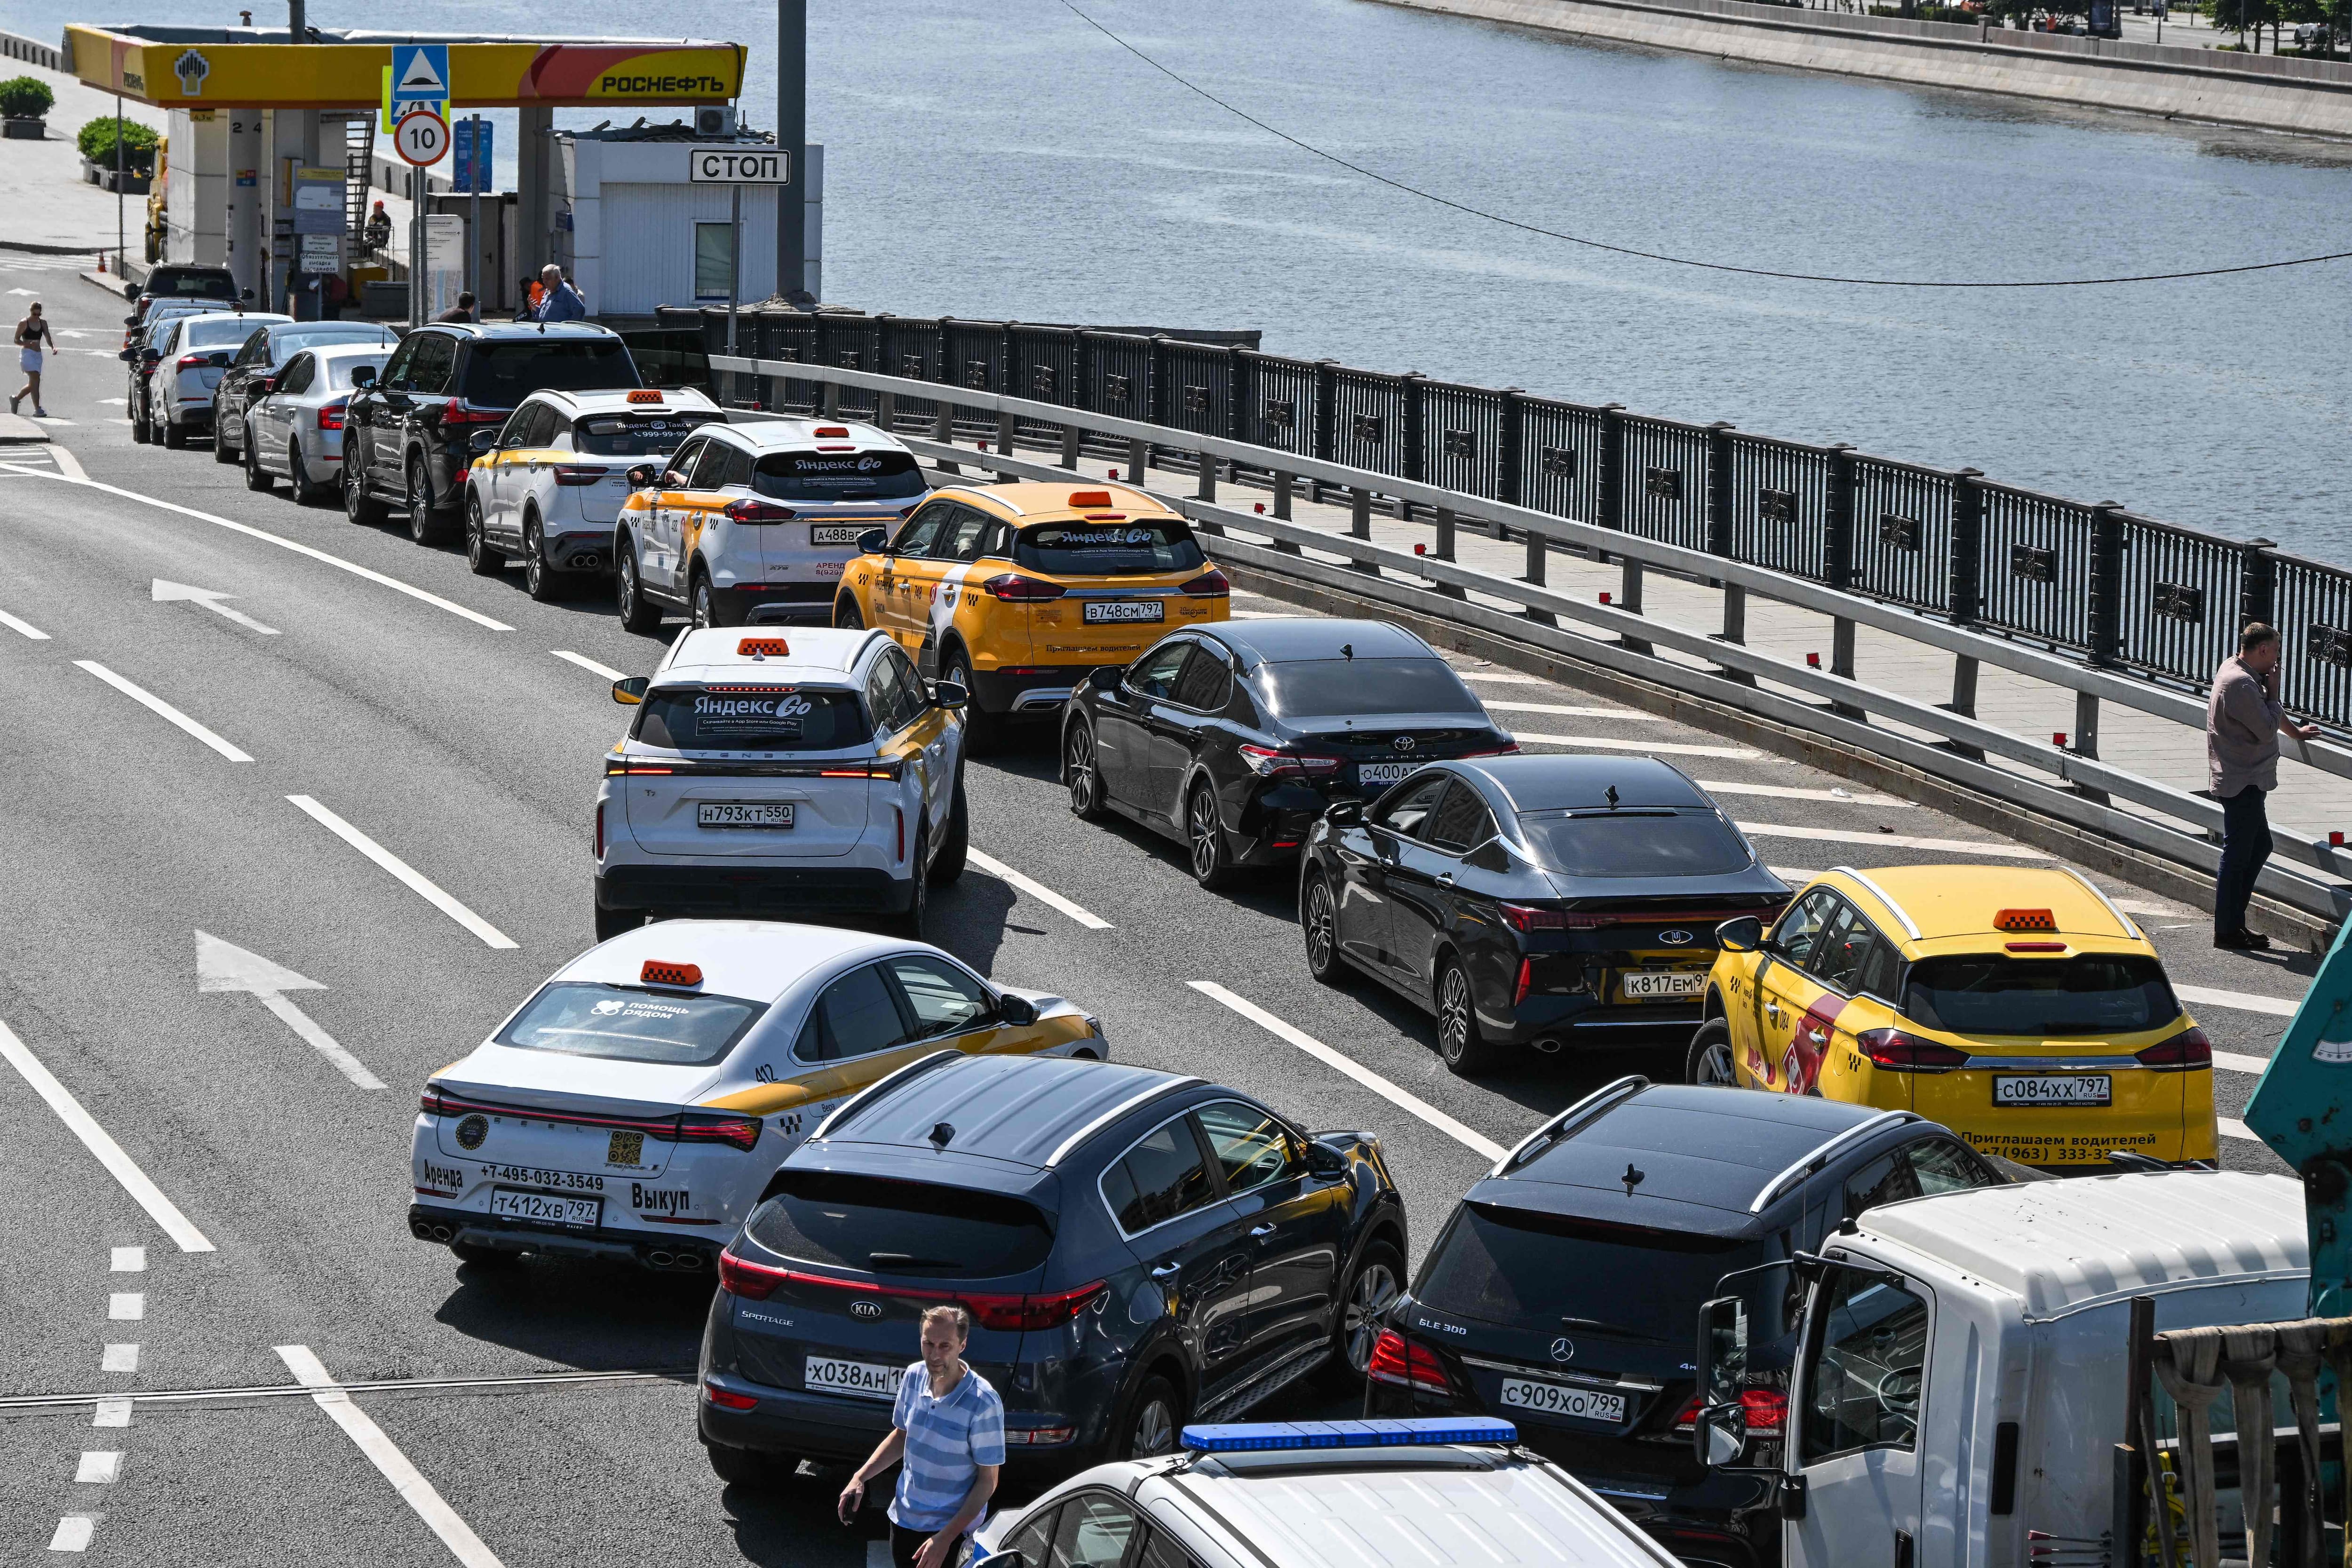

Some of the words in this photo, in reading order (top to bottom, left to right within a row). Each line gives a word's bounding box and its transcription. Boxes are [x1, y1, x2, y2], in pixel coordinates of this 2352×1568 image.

[602, 76, 724, 92] РОСНЕФТЬ
[232, 122, 243, 133] 2
[253, 122, 262, 133] 4
[410, 127, 436, 149] 10
[702, 155, 778, 178] СТОП
[795, 460, 856, 470] Яндекс
[858, 457, 882, 470] Go
[1060, 531, 1125, 543] Яндекс
[1126, 528, 1152, 543] Go
[914, 585, 922, 600] 748
[1090, 604, 1138, 618] В748СМ
[1140, 603, 1159, 613] 797
[694, 696, 774, 716] Яндекс
[776, 694, 811, 717] Go
[704, 806, 763, 821] Н793КТ
[766, 806, 790, 818] 550
[1631, 976, 1693, 993] К817ЕМ
[1780, 1010, 1790, 1033] 084
[755, 1063, 779, 1084] 412
[2003, 1080, 2074, 1098] С084ХХ
[2077, 1078, 2105, 1092] 797
[821, 1103, 836, 1113] Вера
[1961, 1131, 2065, 1146] Приглашаем
[2071, 1134, 2156, 1147] водителей
[424, 1159, 463, 1192] Аренда
[481, 1165, 604, 1191] +7-495-032-3549
[498, 1195, 564, 1218] Т412ХВ
[568, 1201, 594, 1217] 797
[632, 1182, 689, 1217] Выкуп
[741, 1310, 794, 1327] SPORTAGE
[855, 1304, 875, 1316] KIA
[1419, 1318, 1441, 1329] GLE
[1443, 1324, 1467, 1335] 300
[811, 1362, 886, 1389] Х038АН
[1506, 1384, 1585, 1413] С909ХО
[1590, 1393, 1620, 1413] 799
